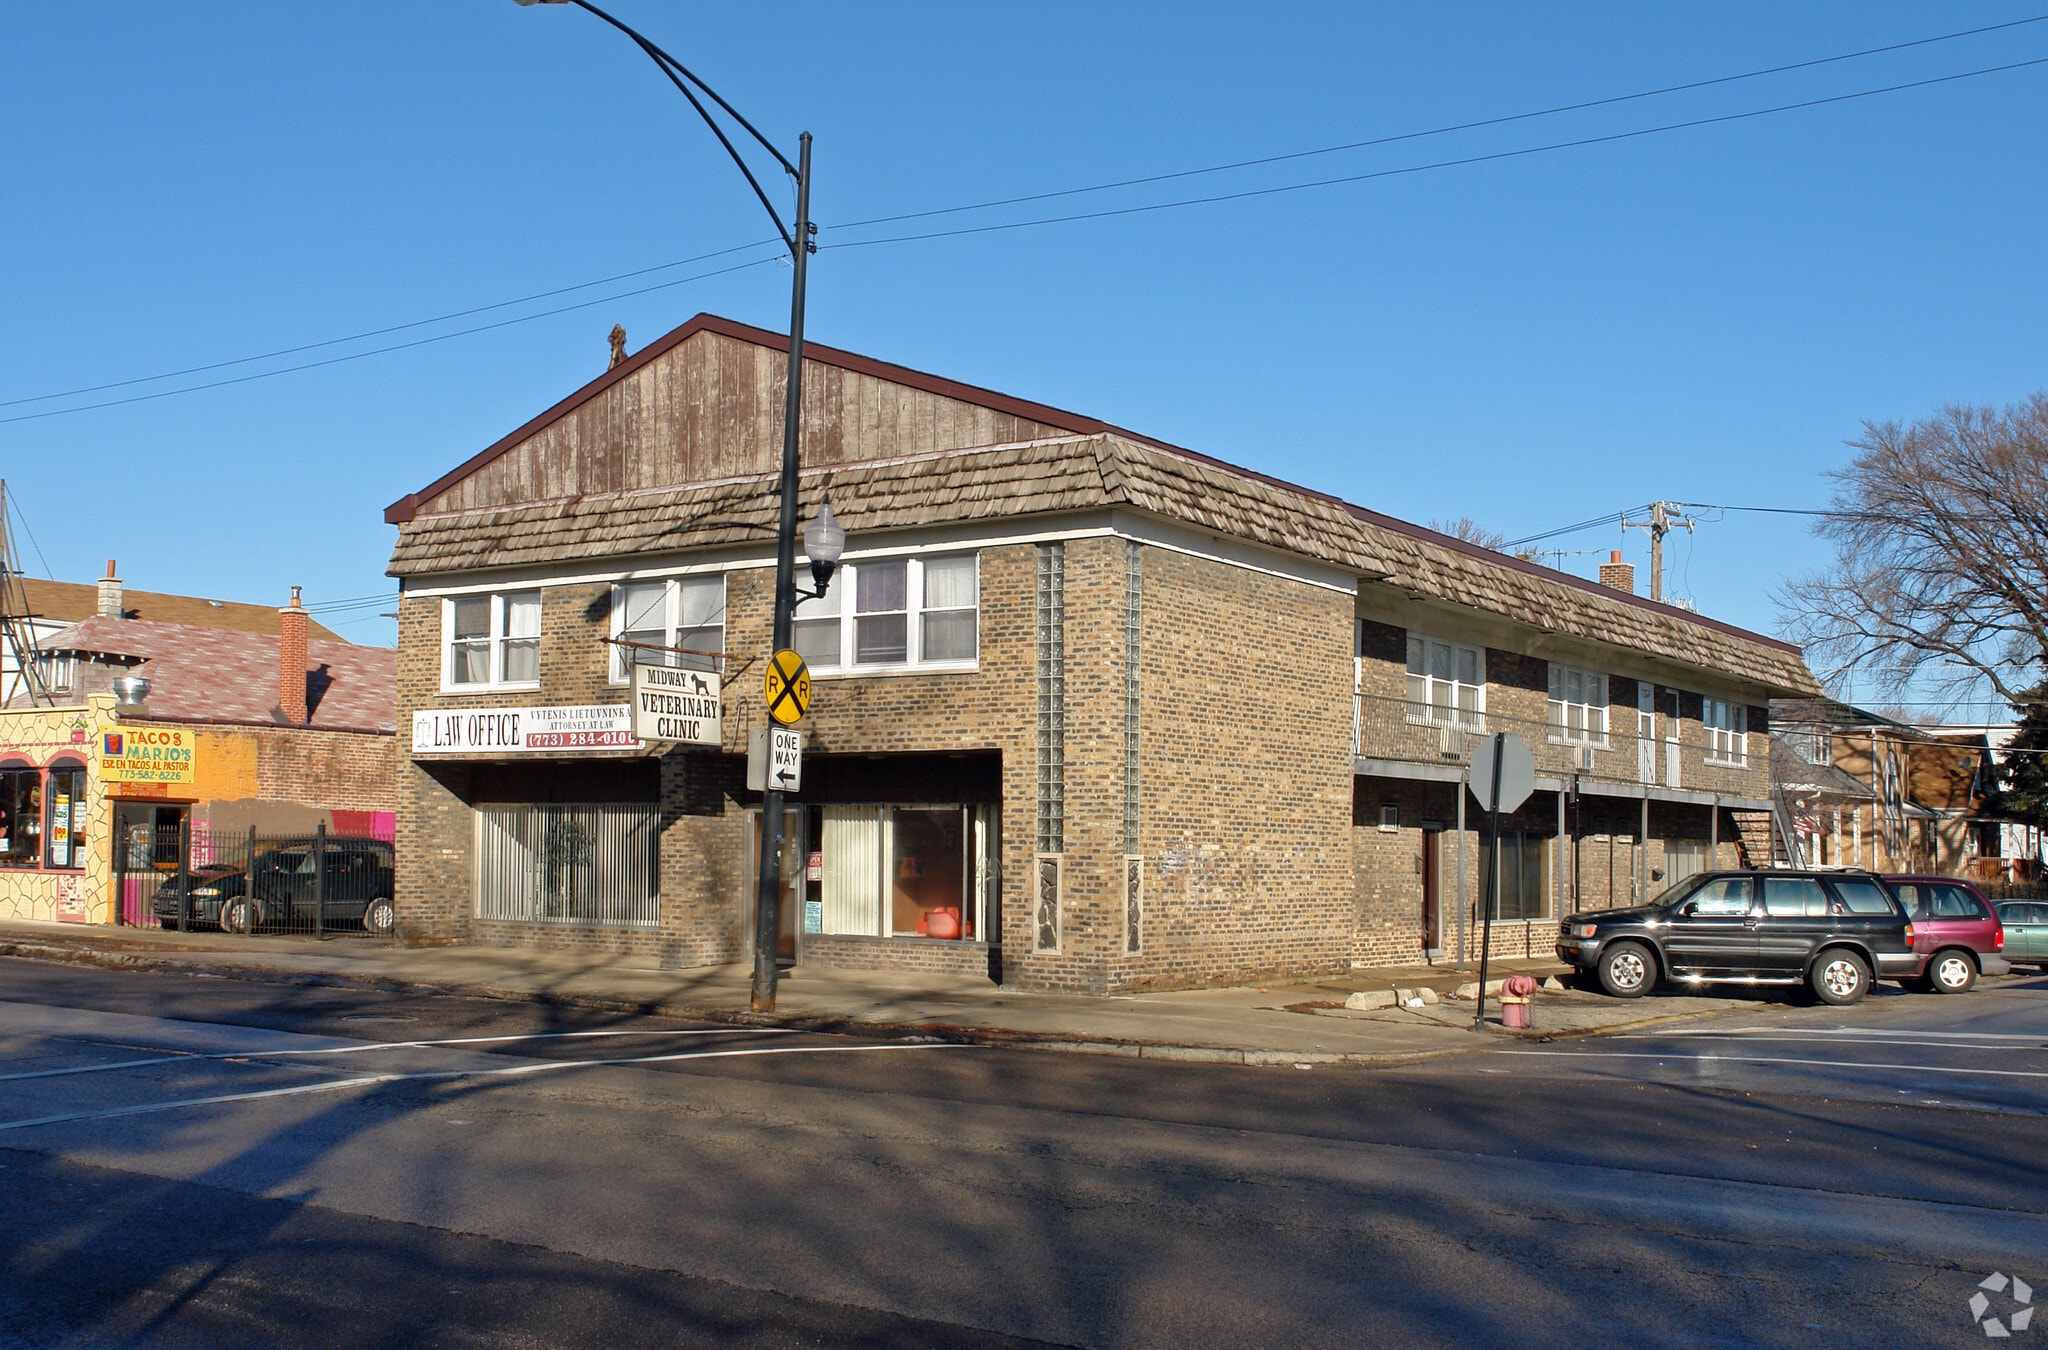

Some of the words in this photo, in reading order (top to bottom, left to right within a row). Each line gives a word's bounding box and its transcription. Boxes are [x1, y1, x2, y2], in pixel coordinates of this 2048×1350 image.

[647, 669, 687, 687] MIDWAY
[769, 676, 778, 693] R
[799, 681, 808, 698] R
[641, 693, 717, 719] VETERINARY
[530, 709, 567, 720] VYTENIS
[434, 715, 463, 747] LAW
[468, 714, 520, 747] OFFICE
[550, 721, 586, 731] ATTORNEY
[588, 720, 599, 730] AT
[599, 720, 615, 729] LAW
[657, 717, 700, 740] CLINIC
[126, 731, 182, 746] TACOS
[529, 733, 564, 747] (773)
[776, 734, 798, 750] ONE
[125, 746, 191, 761] MARIO'S
[775, 751, 798, 766] WAY
[116, 760, 126, 769] EN
[128, 760, 150, 770] TACOS
[152, 761, 162, 770] AL
[163, 762, 189, 771] PASTOR
